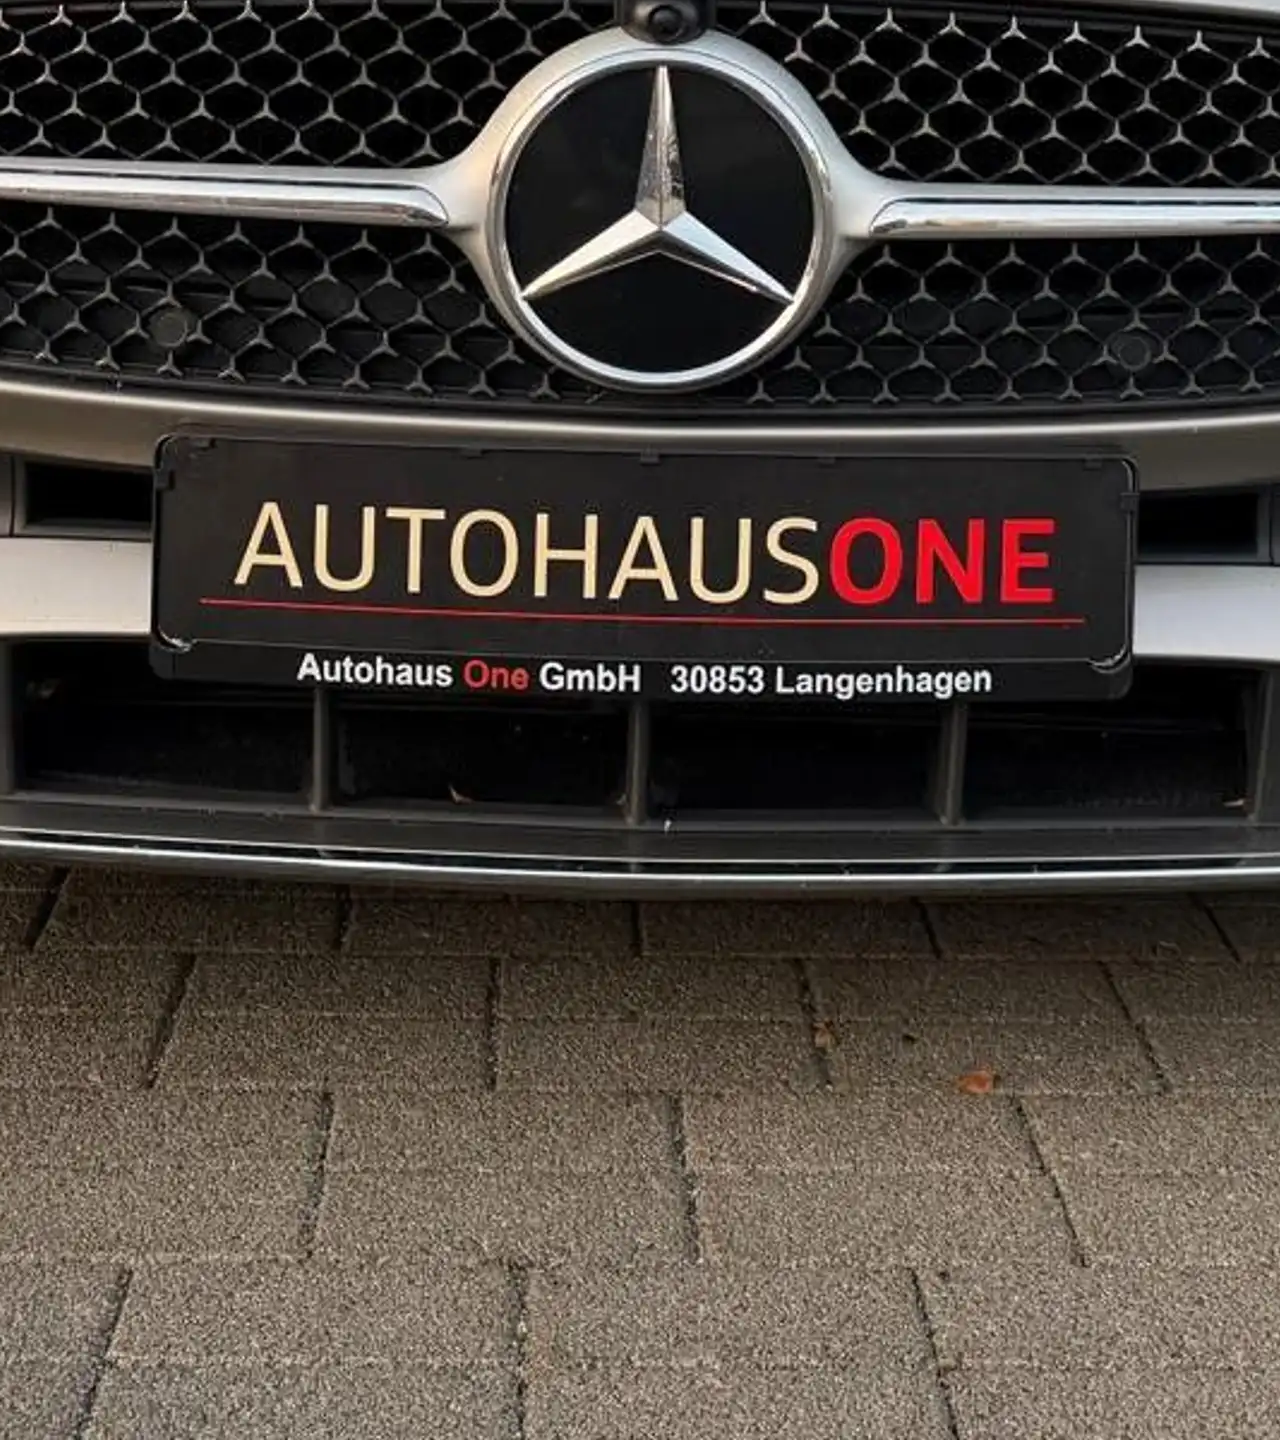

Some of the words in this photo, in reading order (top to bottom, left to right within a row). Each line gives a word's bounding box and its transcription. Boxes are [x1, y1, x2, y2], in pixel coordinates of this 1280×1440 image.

[296, 652, 453, 688] Autohaus
[463, 659, 530, 691] One
[538, 661, 641, 693] GmbH
[671, 664, 765, 694] 30853
[775, 664, 993, 700] Langenhagen
